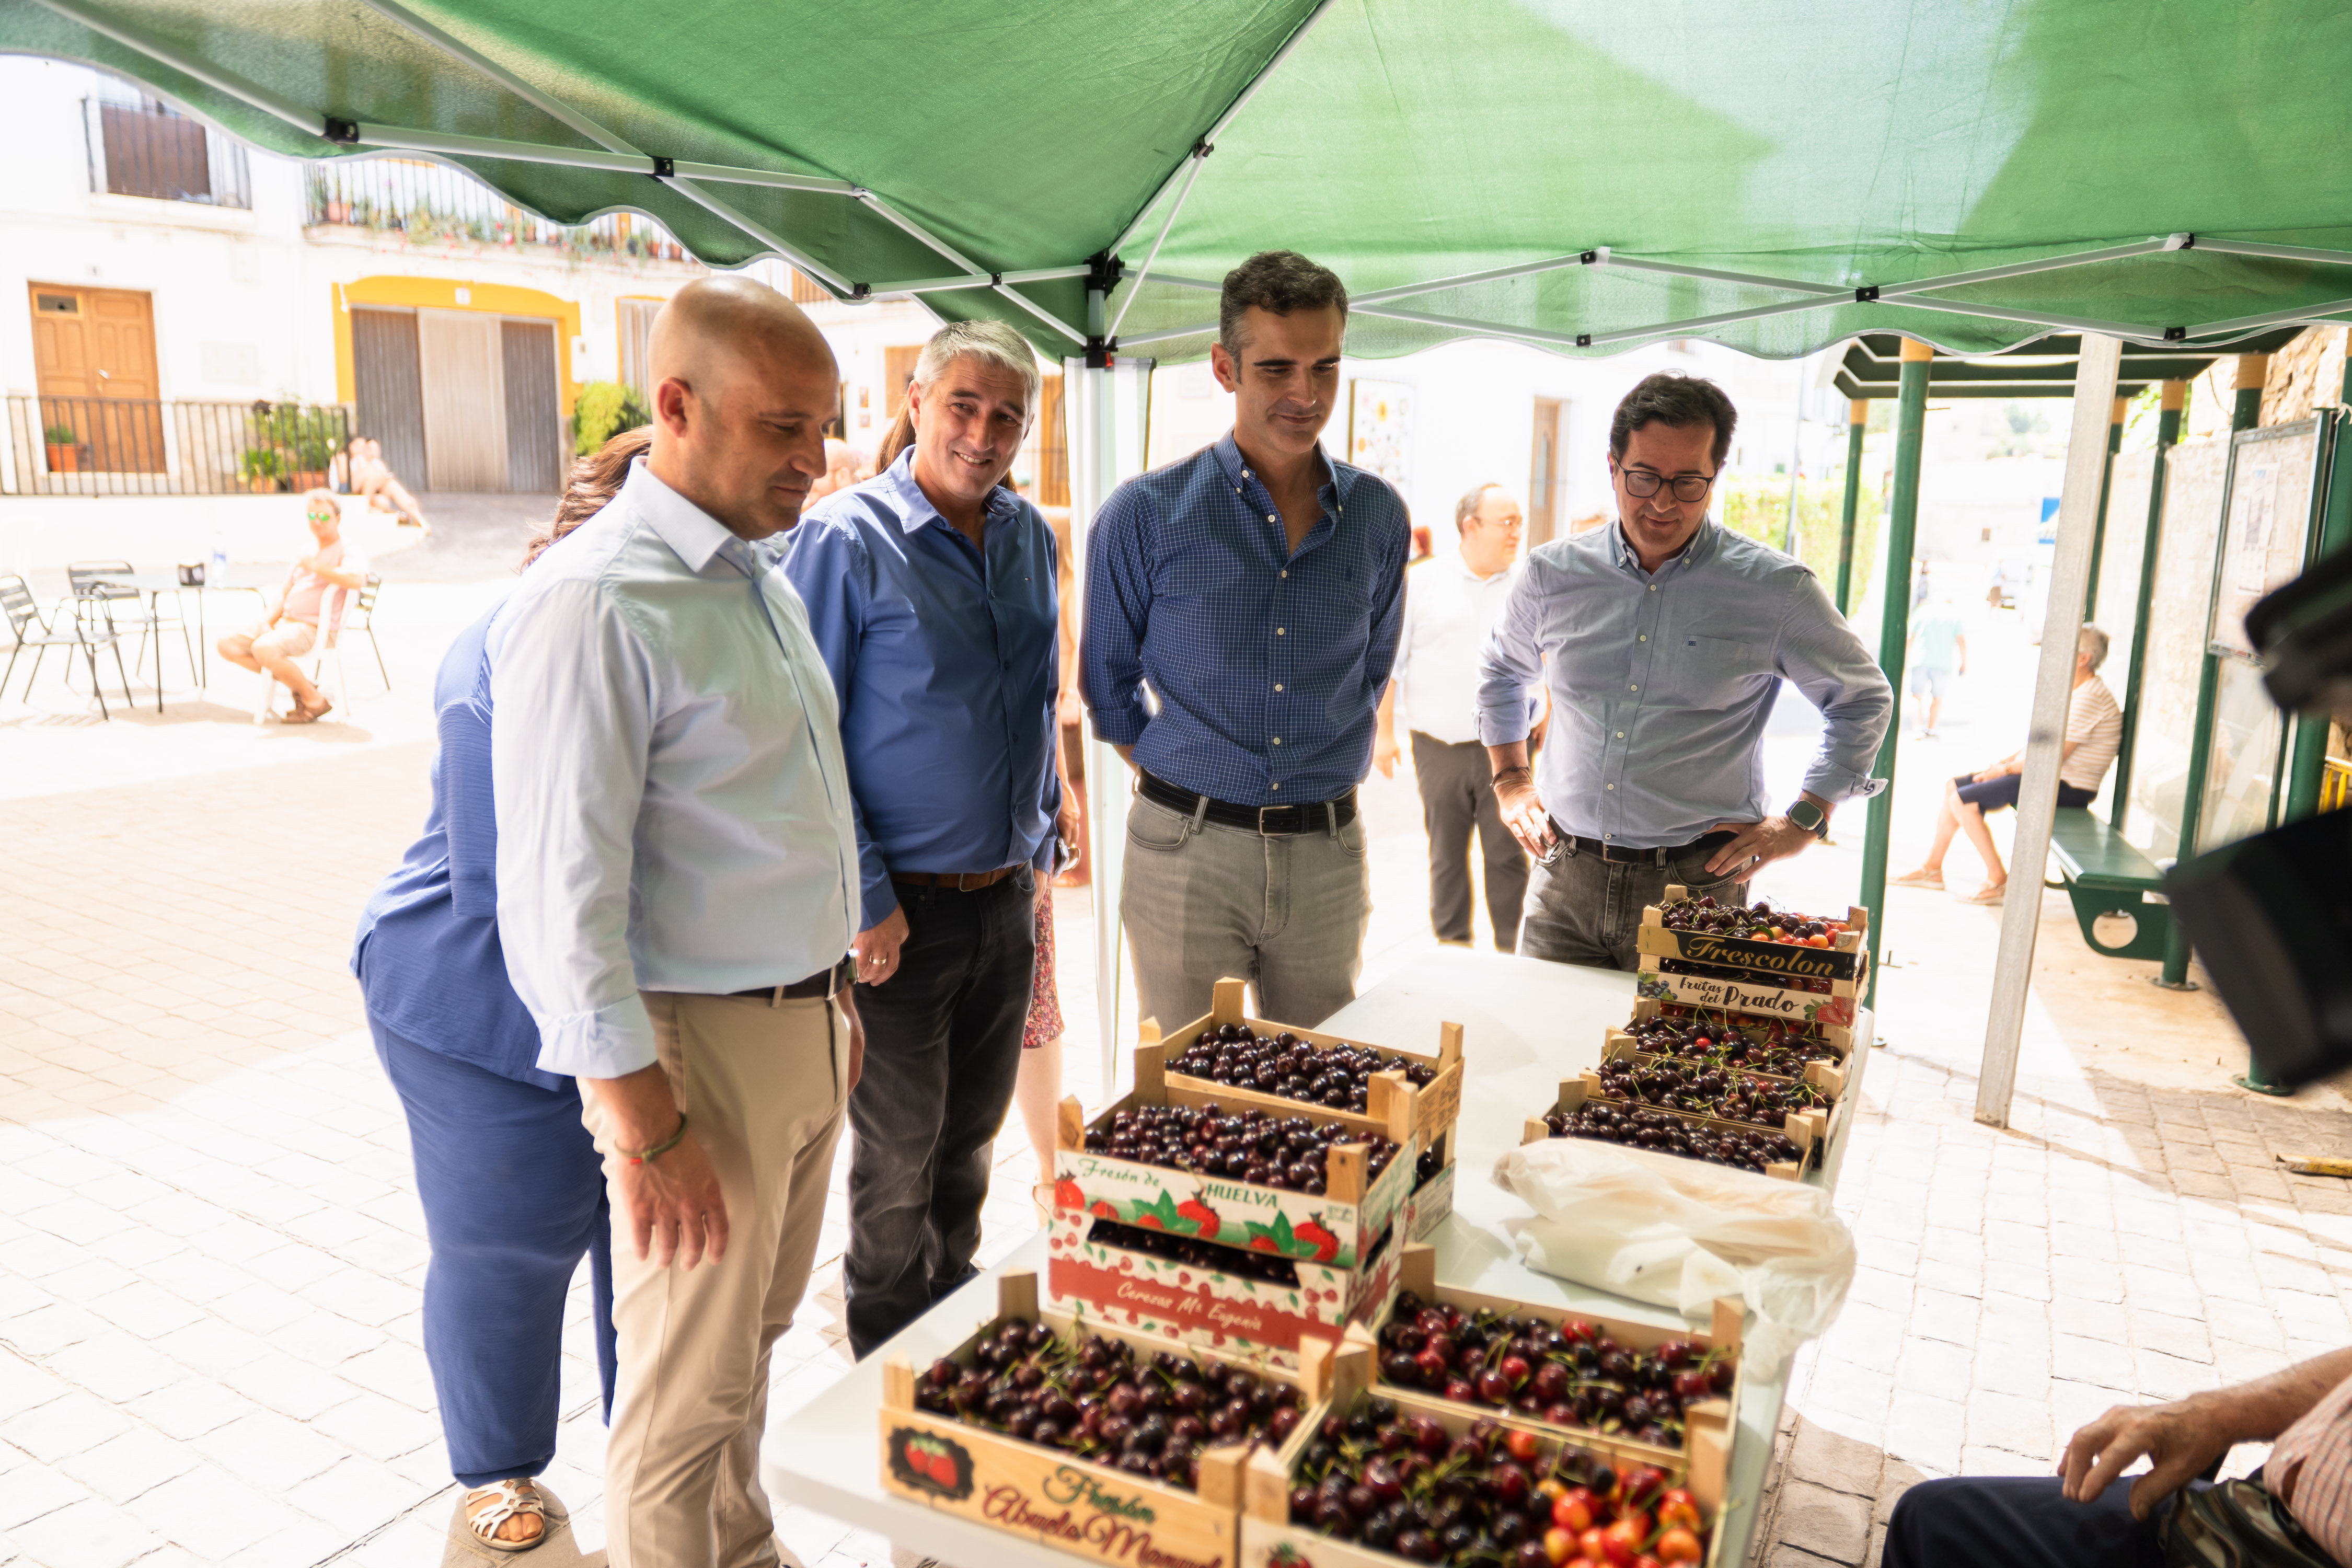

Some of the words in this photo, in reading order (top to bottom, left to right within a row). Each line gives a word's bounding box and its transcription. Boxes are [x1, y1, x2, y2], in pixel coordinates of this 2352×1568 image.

[1687, 936, 1838, 976] Frescolon
[1680, 977, 1725, 993] Frutas
[1700, 991, 1722, 1004] del
[1724, 986, 1800, 1012] Prado
[1078, 1157, 1138, 1182] Fresón
[1144, 1171, 1159, 1186] de
[1206, 1182, 1277, 1208] HUELVA
[1117, 1281, 1173, 1309] Cerezas
[1208, 1303, 1262, 1331] Eugenia
